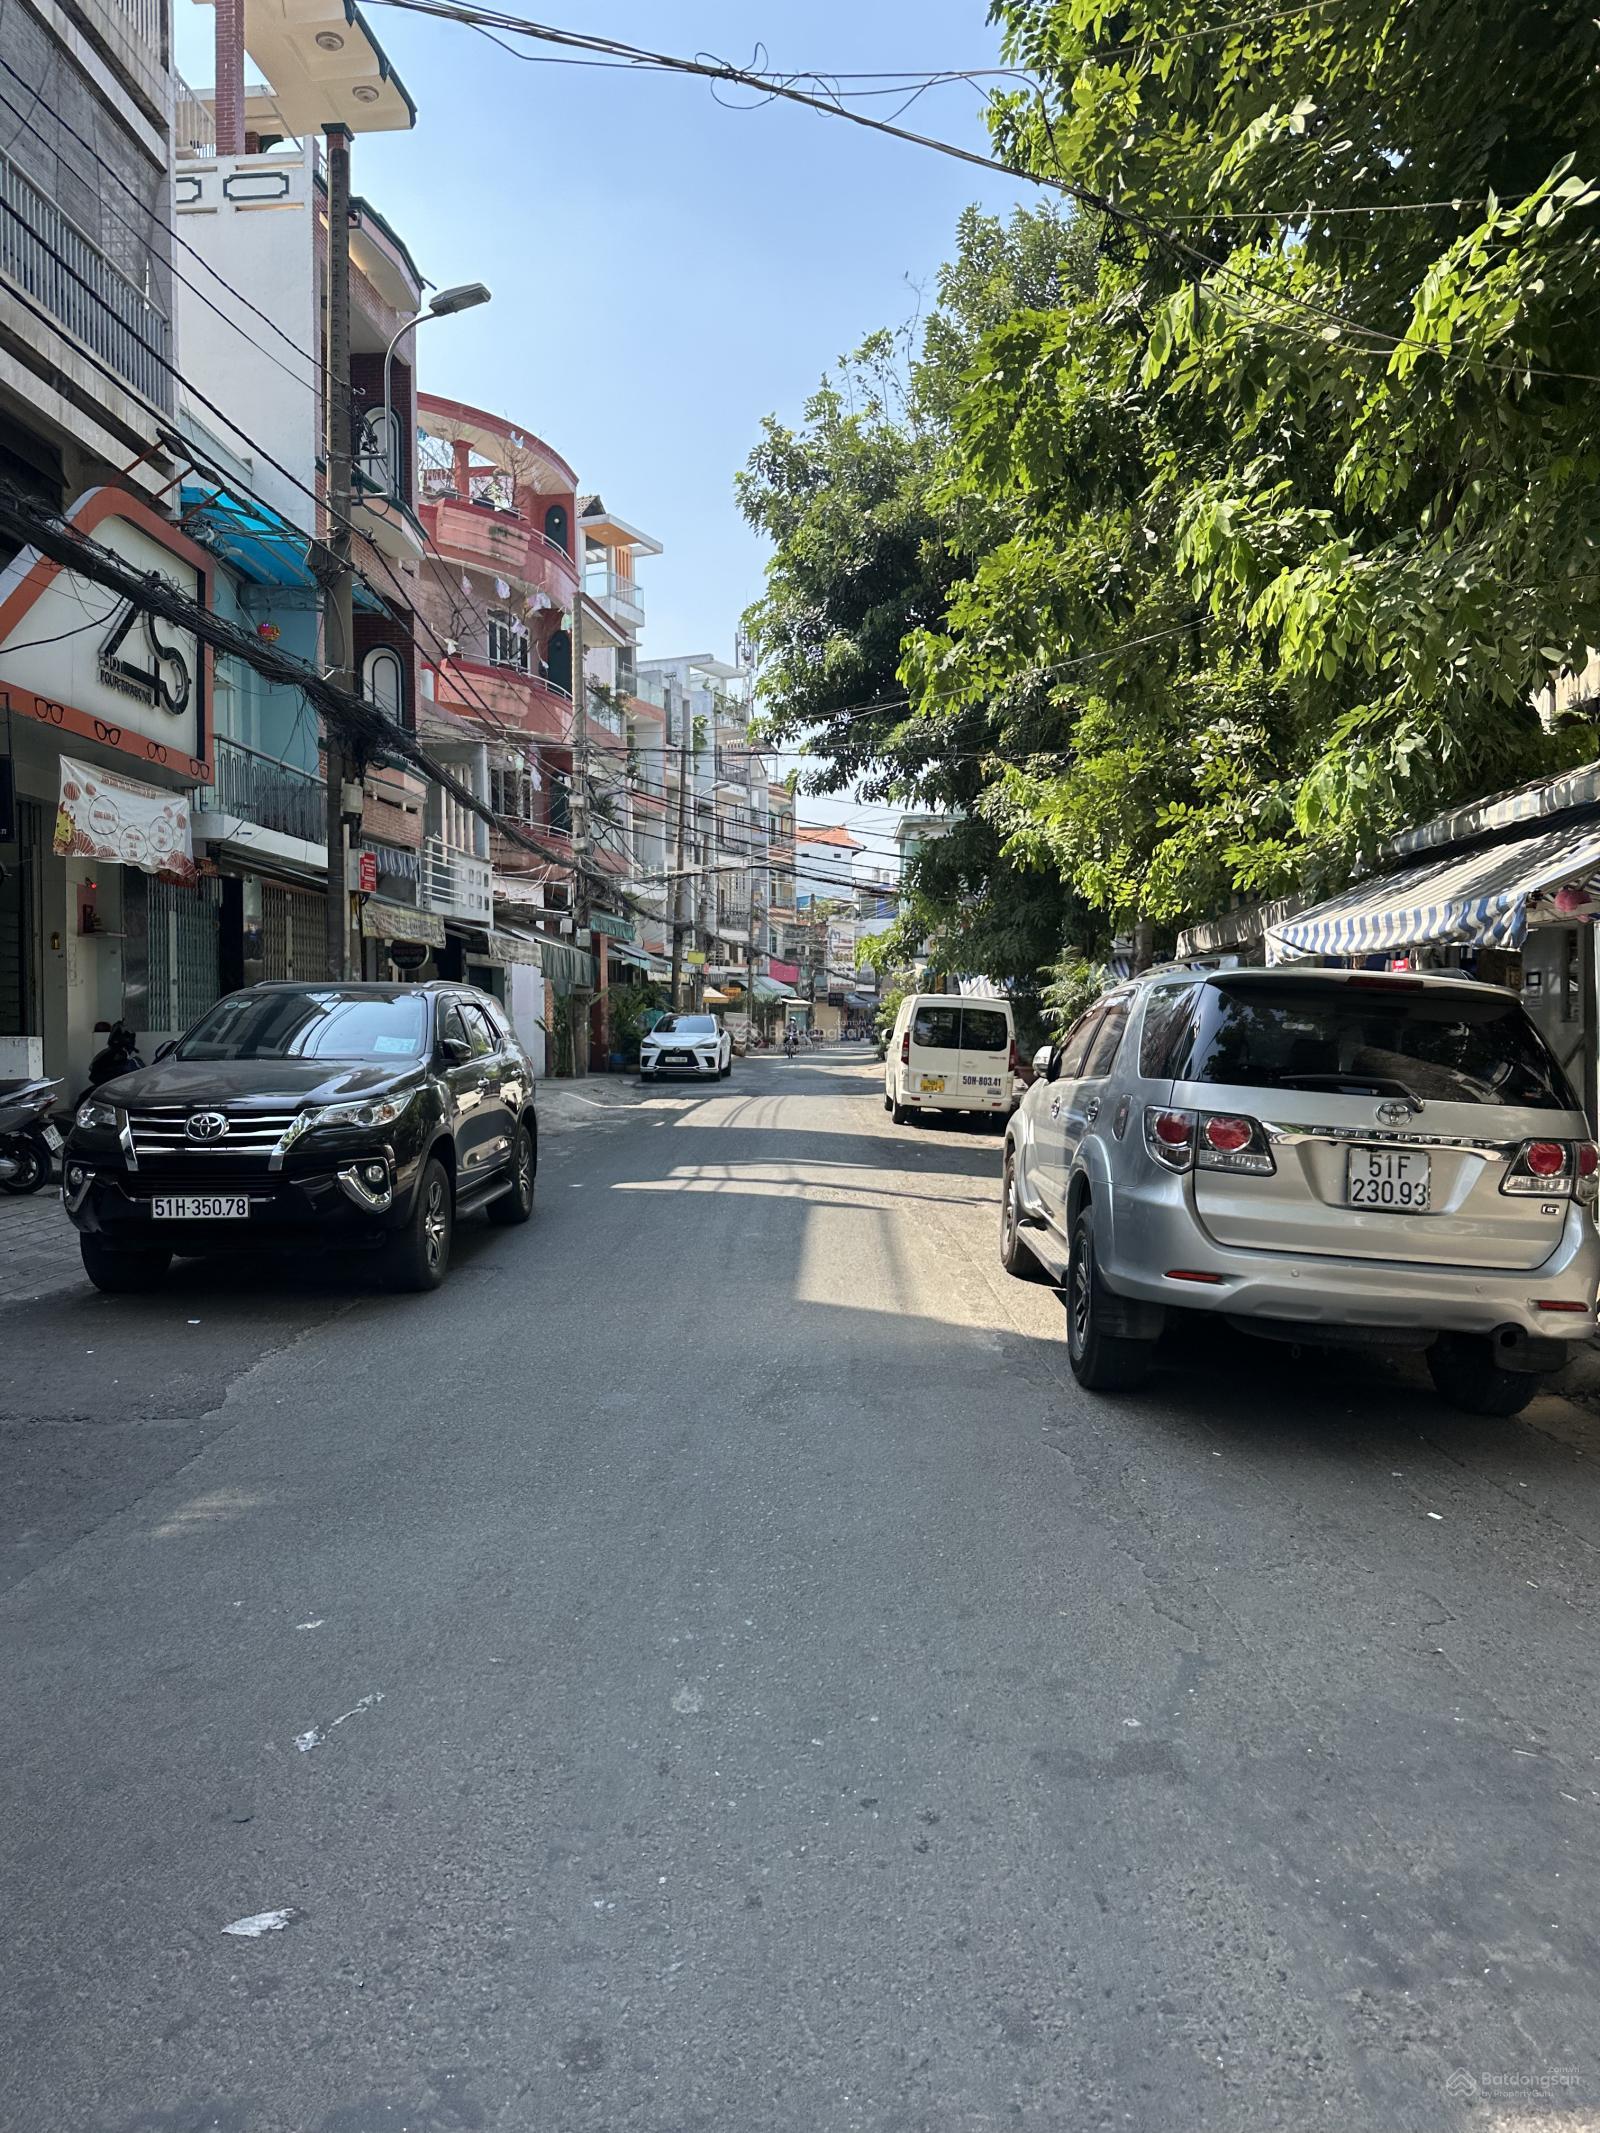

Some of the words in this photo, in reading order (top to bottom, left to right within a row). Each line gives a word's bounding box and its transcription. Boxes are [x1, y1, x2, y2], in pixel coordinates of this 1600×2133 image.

[1369, 1154, 1411, 1179] 51F
[1352, 1178, 1427, 1206] 230.93
[154, 1198, 246, 1217] 51H-350.78
